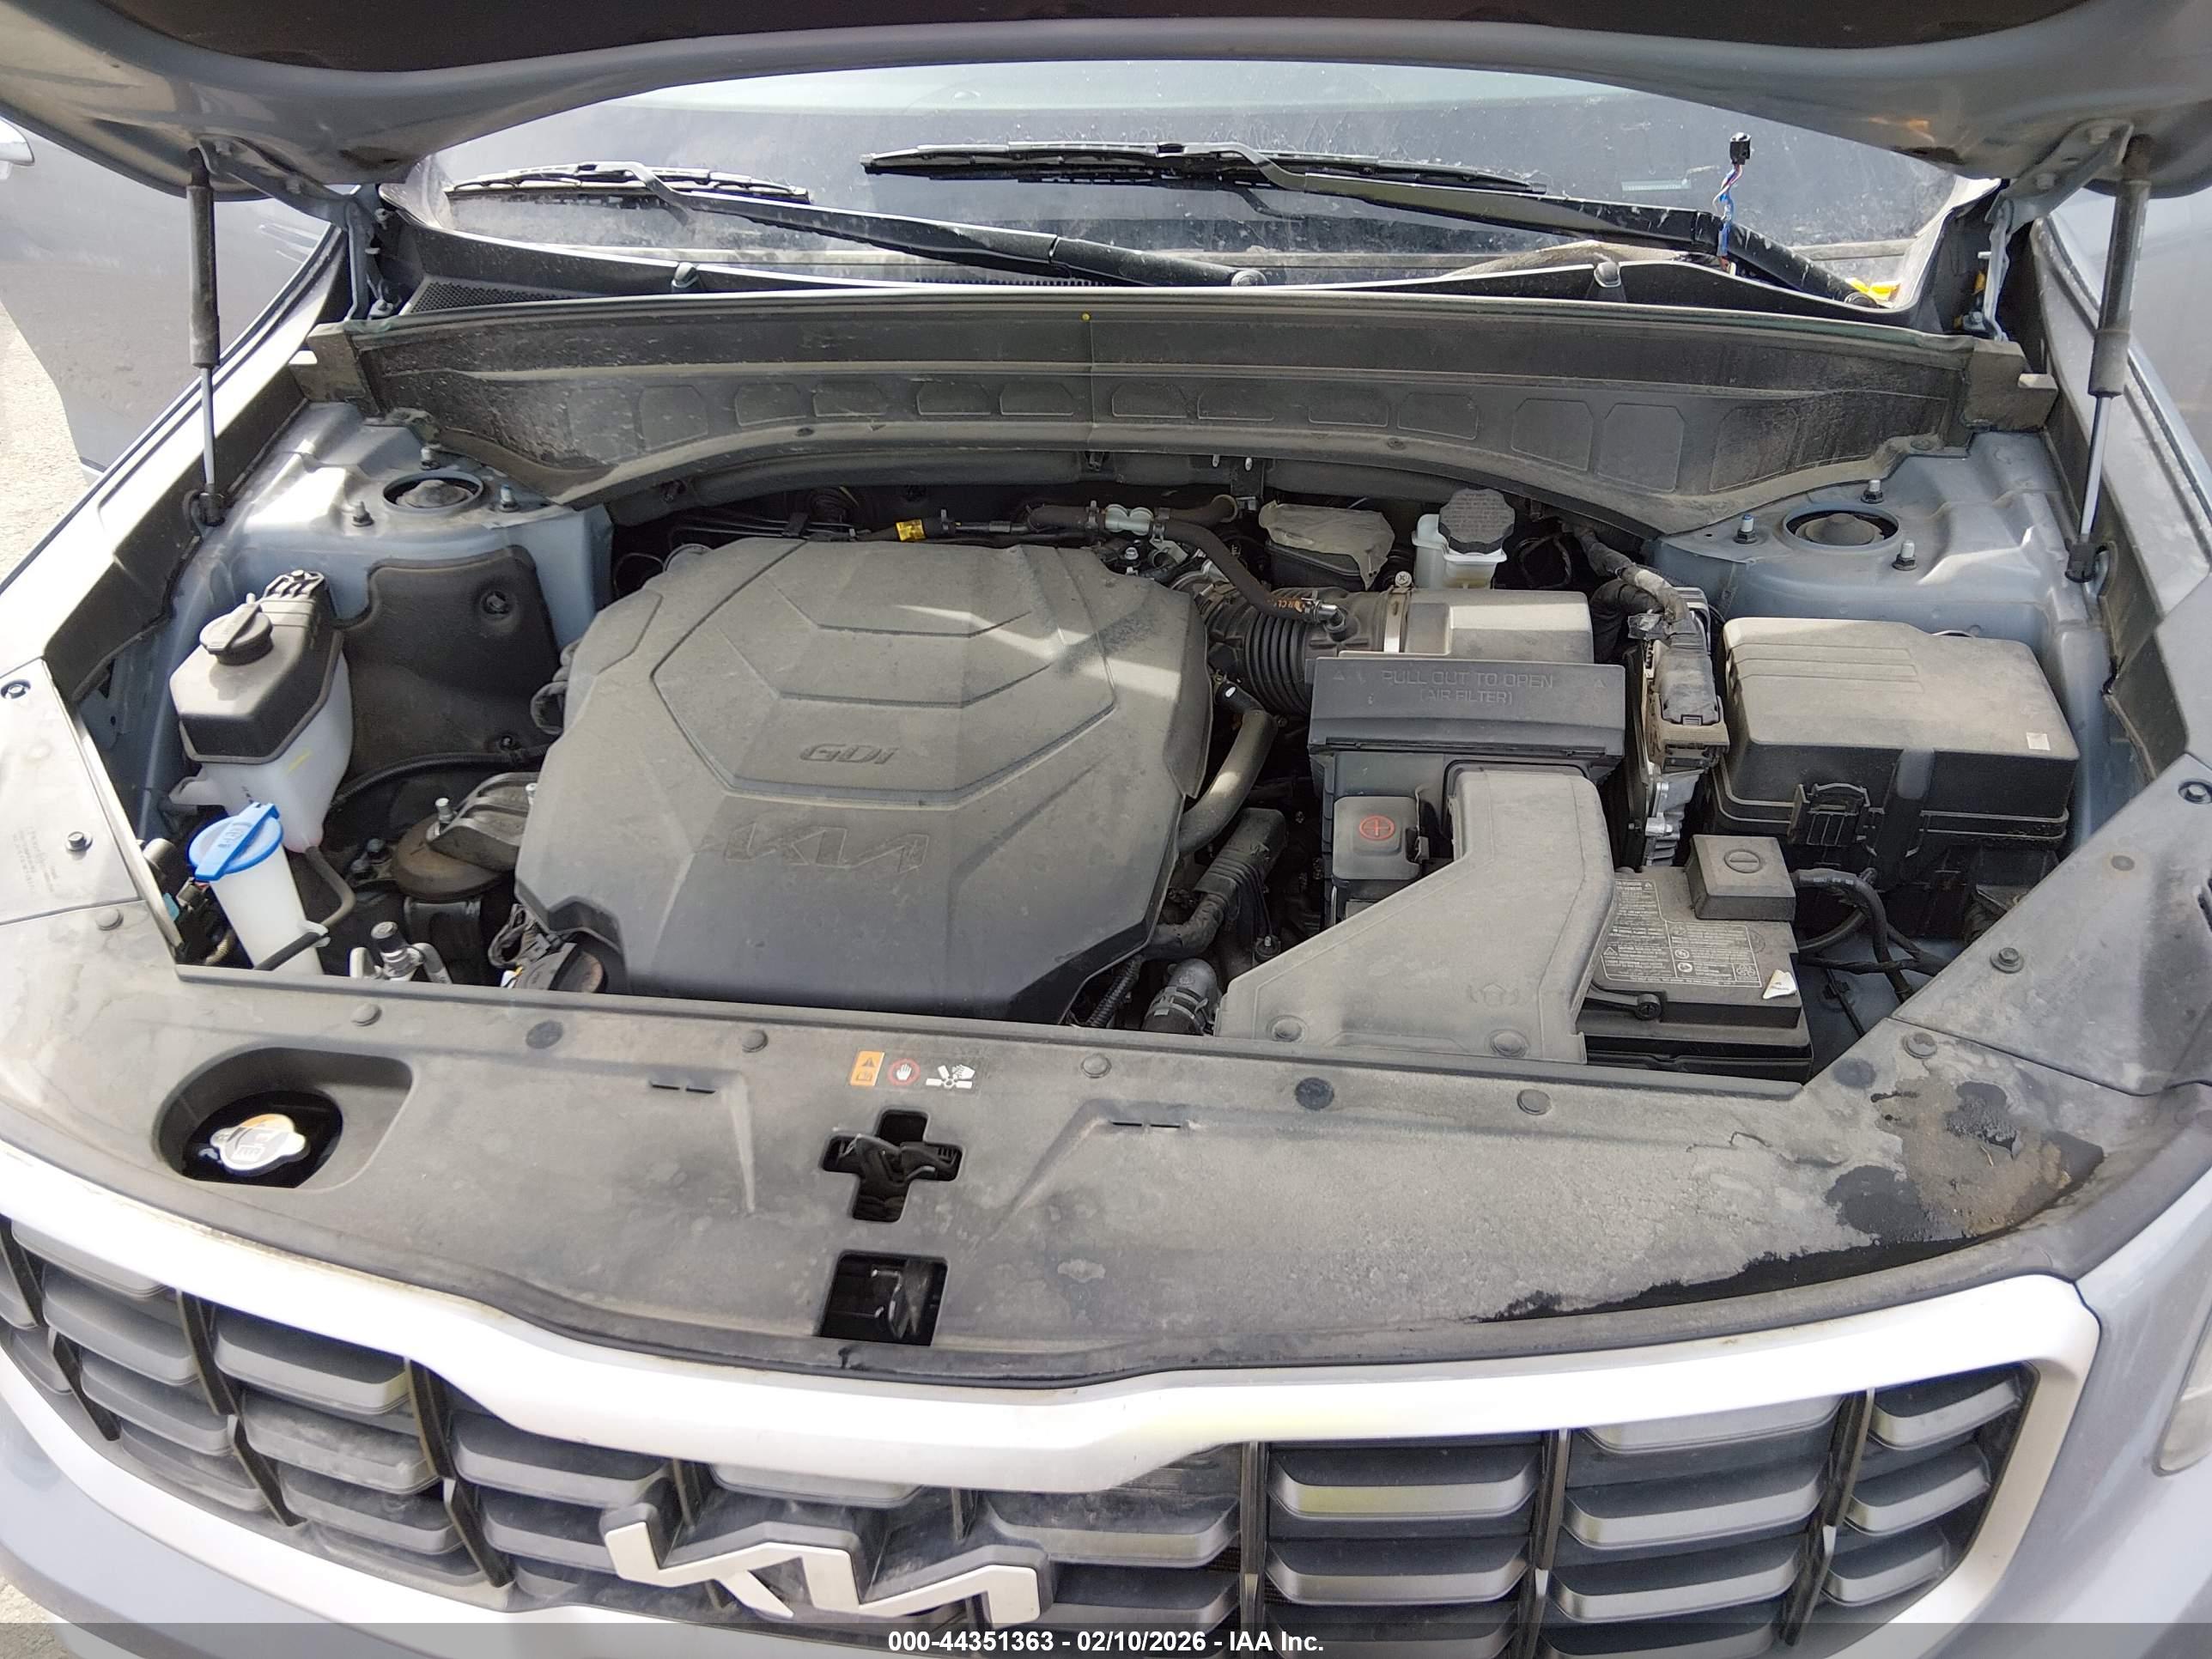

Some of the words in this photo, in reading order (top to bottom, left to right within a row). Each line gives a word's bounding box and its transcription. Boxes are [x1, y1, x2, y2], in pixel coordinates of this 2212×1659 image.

[1381, 670, 1428, 684] PULL
[1431, 671, 1471, 685] OUT
[1475, 672, 1498, 687] TO
[1504, 673, 1553, 688] OPEN
[724, 822, 929, 874] KIA
[605, 1521, 1040, 1630] KIA
